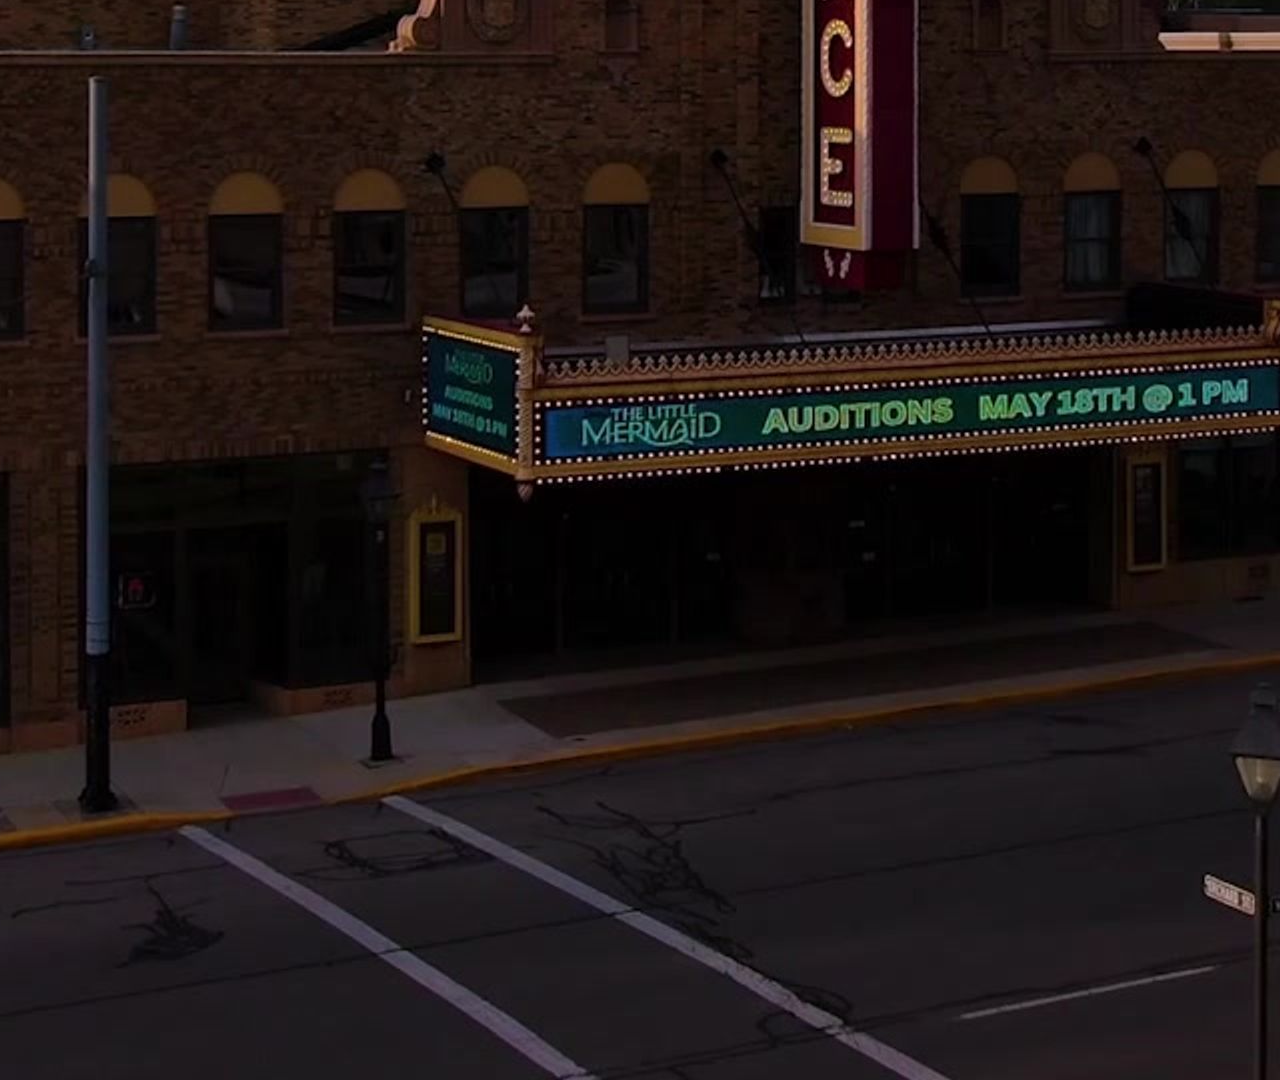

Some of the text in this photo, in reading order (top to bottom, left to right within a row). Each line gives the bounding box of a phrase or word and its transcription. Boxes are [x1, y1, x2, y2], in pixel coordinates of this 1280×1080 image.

[611, 403, 697, 421] THE LITTLE
[762, 378, 1250, 436] AUDITIONS MAY 18TH @ 1 PM
[581, 411, 722, 447] MERMAID
